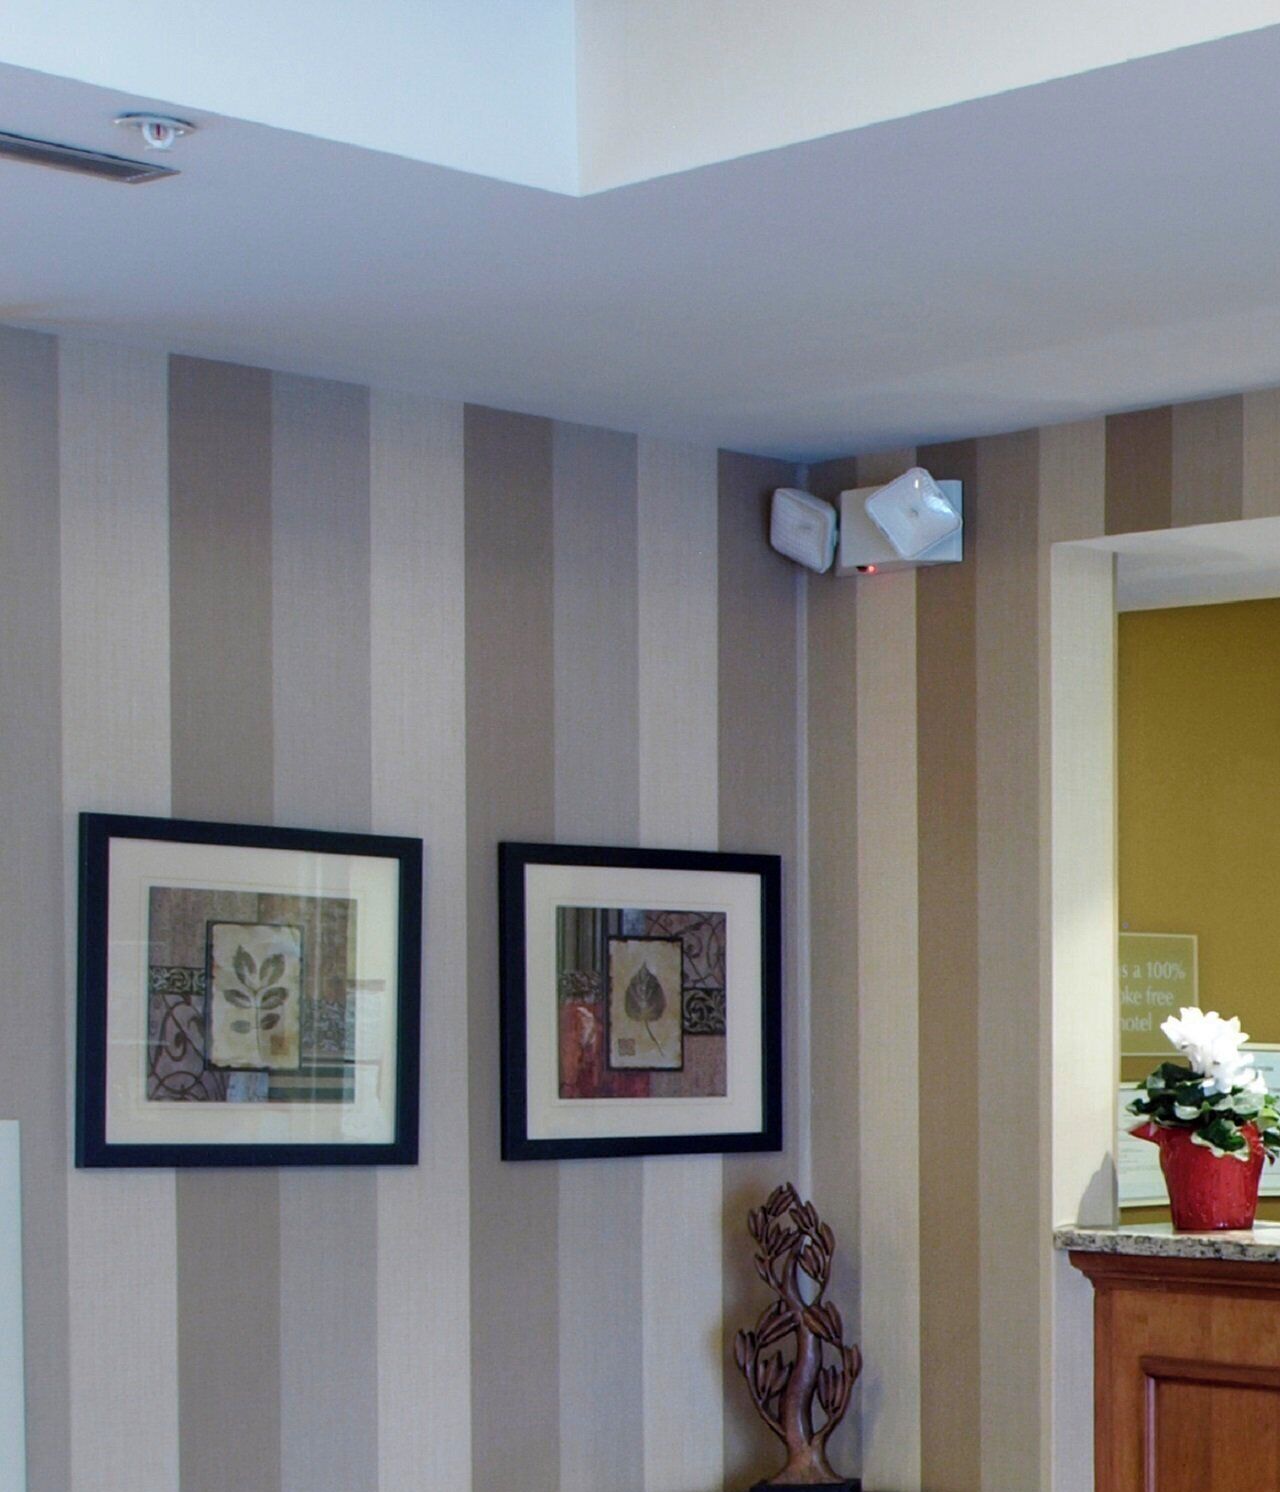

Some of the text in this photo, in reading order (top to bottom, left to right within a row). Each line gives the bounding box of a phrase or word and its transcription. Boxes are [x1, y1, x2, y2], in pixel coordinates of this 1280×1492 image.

[1133, 964, 1143, 979] a
[1147, 960, 1186, 980] 100%
[1146, 986, 1174, 1006] free
